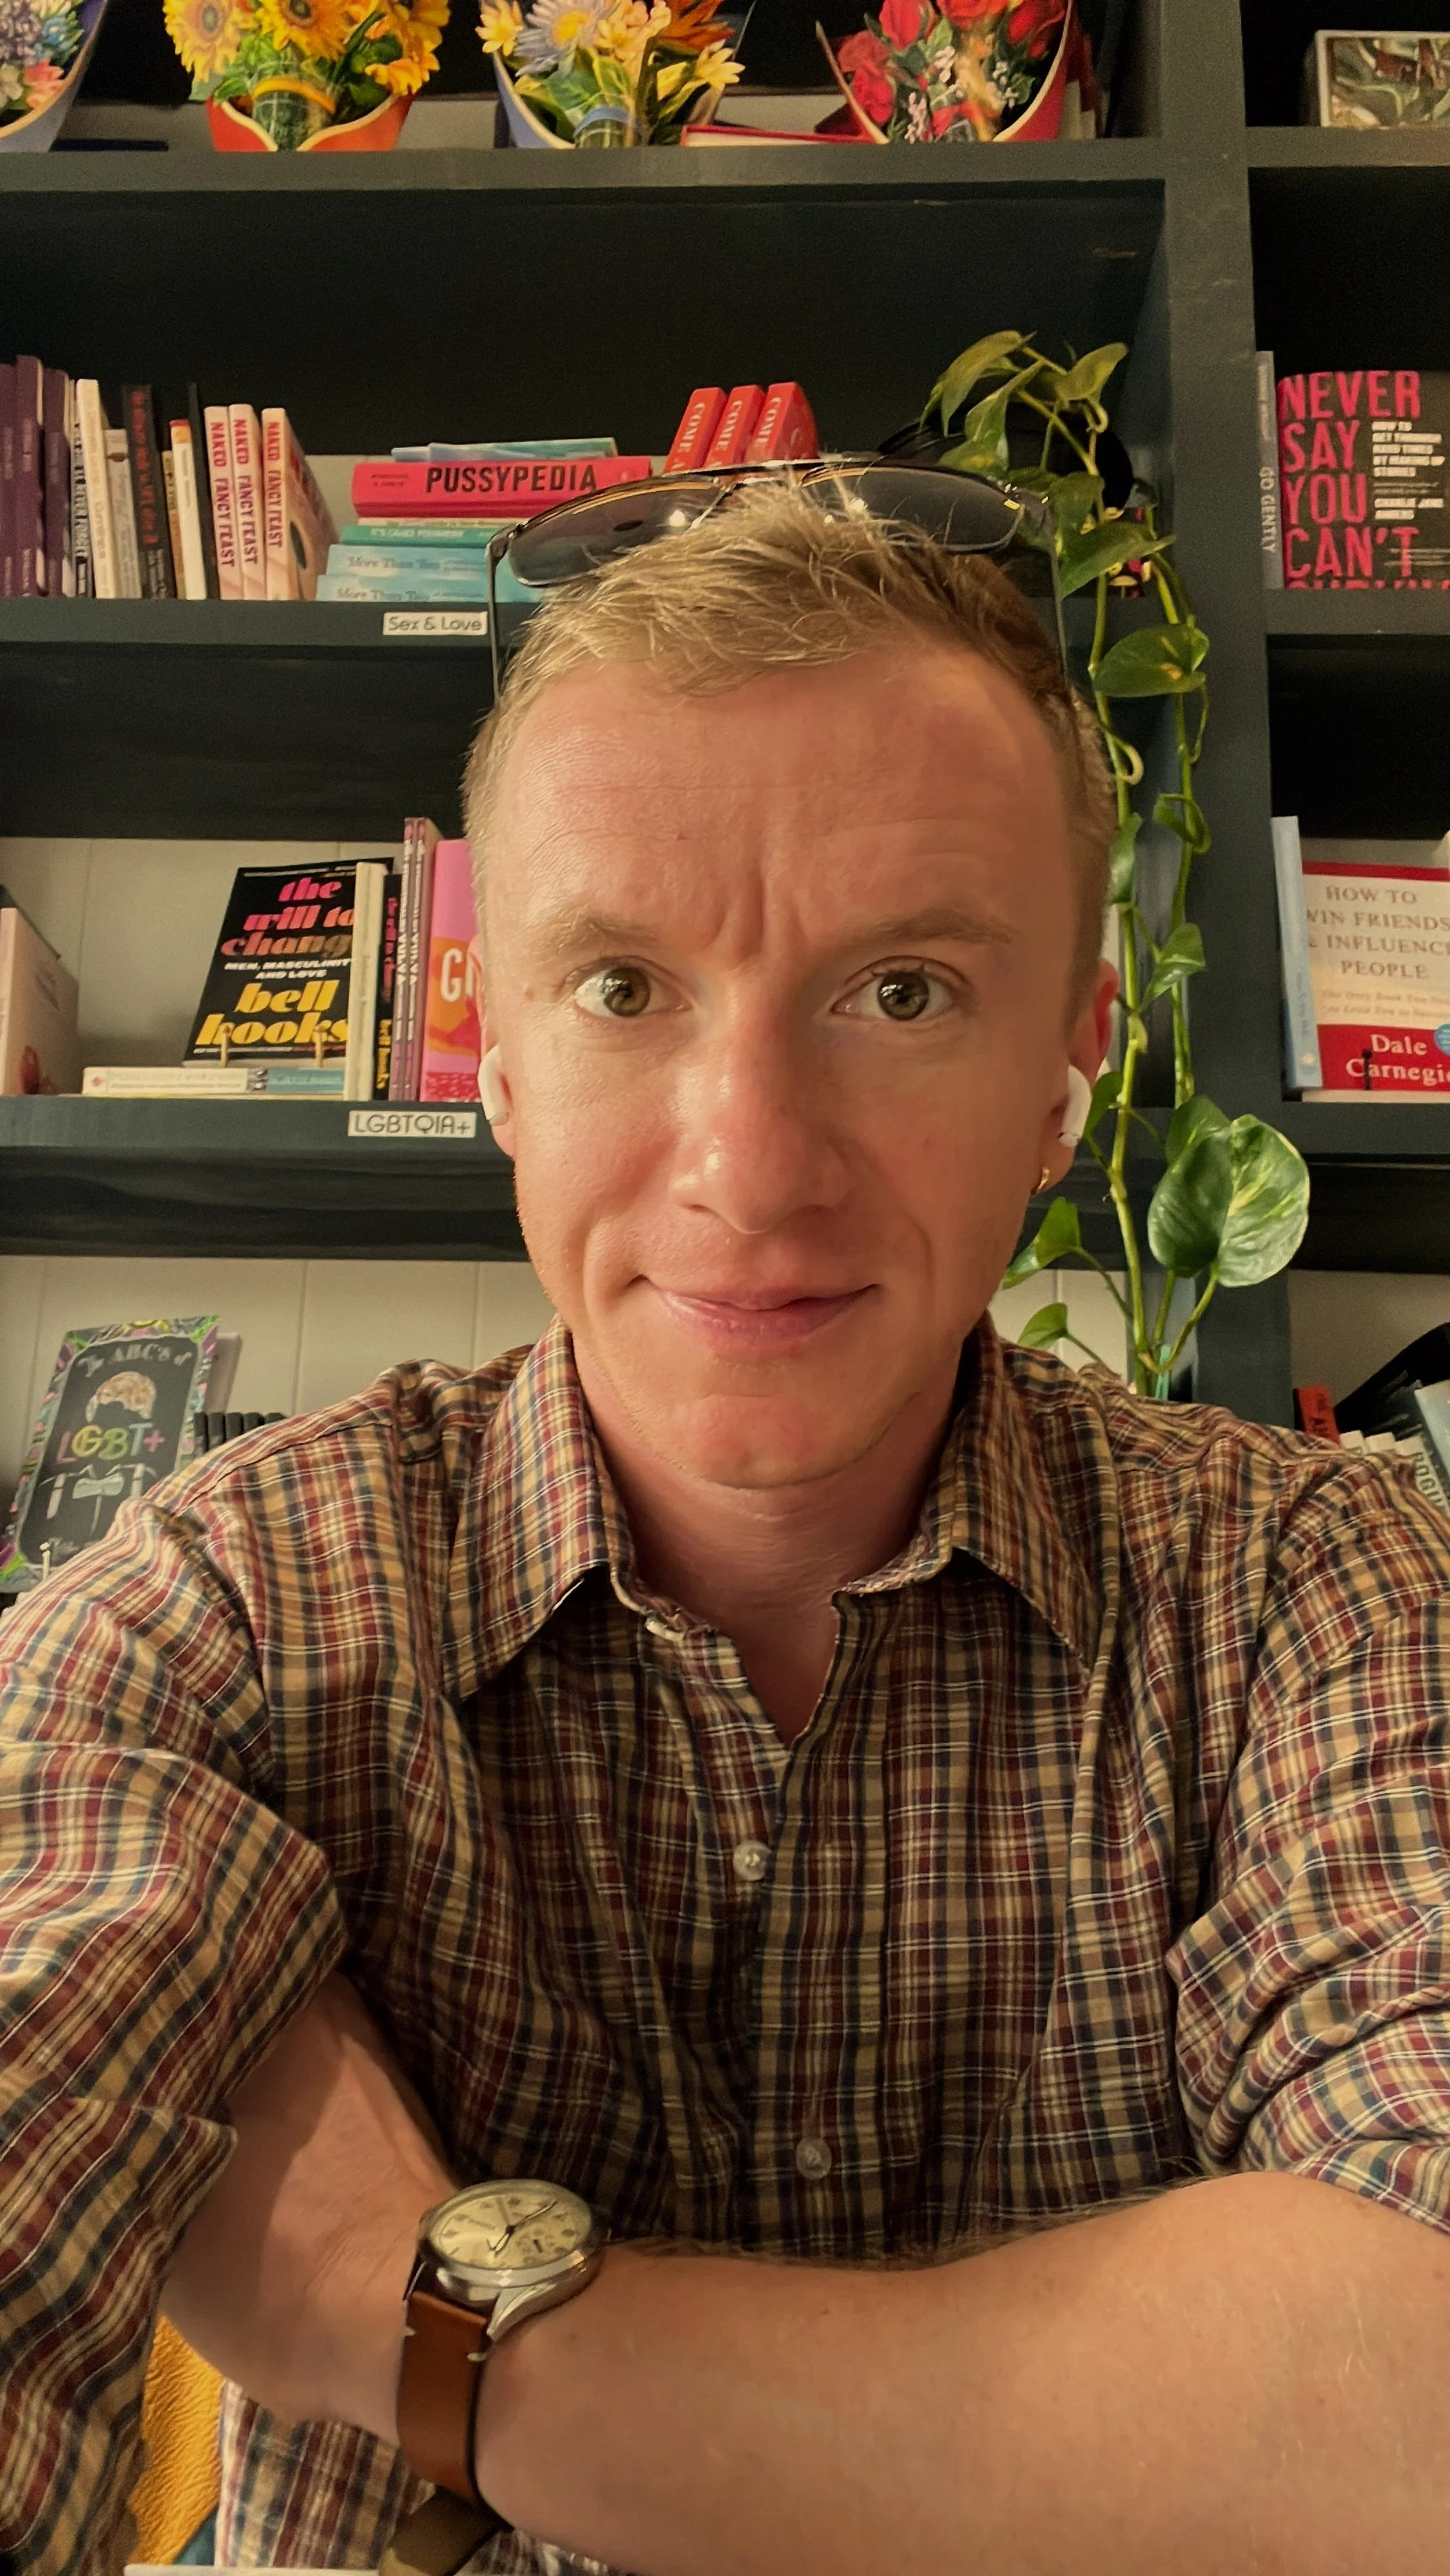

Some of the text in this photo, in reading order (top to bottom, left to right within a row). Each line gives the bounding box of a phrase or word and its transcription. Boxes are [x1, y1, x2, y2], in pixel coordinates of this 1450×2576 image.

[1278, 371, 1420, 420] NEVER
[677, 402, 706, 453] COME
[715, 399, 743, 451] COME
[1281, 419, 1360, 474] SAY
[211, 422, 235, 567] NAKED FANCY FEAST
[233, 419, 258, 564] NAKED FANCY FEAST
[267, 422, 282, 549] NAKED FANCY FEAST
[426, 465, 597, 493] PUSSYPEDIA
[1259, 466, 1277, 554] GO GENTLY
[1284, 473, 1367, 525] YOU
[1284, 525, 1420, 579] CAN'T
[388, 616, 483, 631] Sex & Love
[278, 876, 342, 902] the
[1325, 886, 1418, 904] HOW TO
[242, 904, 355, 931] will to
[1353, 911, 1450, 931] FRIENDS
[220, 931, 353, 959] chang
[1326, 934, 1450, 956] INFLUENC
[255, 969, 327, 979] AND LOVE
[1340, 959, 1430, 979] PEOPLE
[233, 979, 340, 1013] bell
[195, 1011, 348, 1046] hooks
[1370, 1033, 1428, 1056] Dale
[1345, 1057, 1450, 1087] Carnegi
[354, 1113, 470, 1134] LGBTQIA+
[56, 1421, 165, 1465] LGBT+
